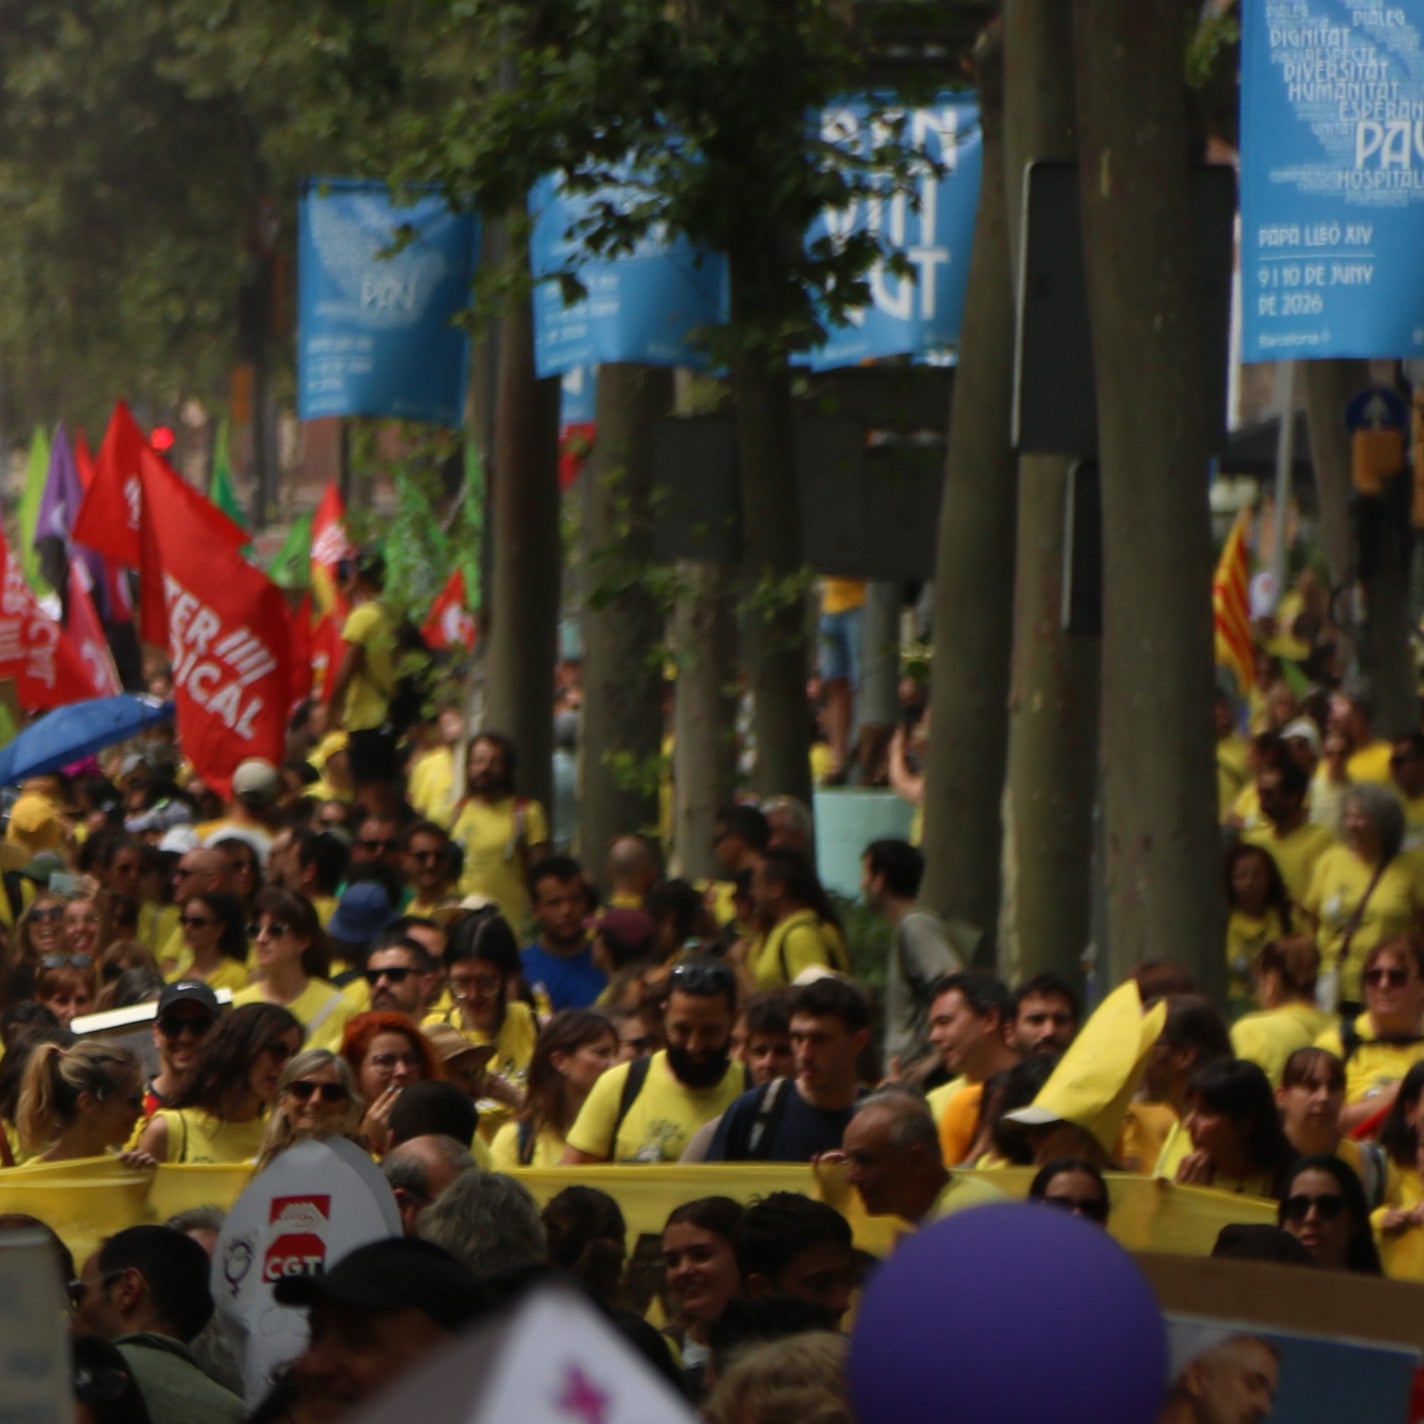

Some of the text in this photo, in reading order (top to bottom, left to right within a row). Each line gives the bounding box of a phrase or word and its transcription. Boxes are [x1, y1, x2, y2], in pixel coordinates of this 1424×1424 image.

[1269, 27, 1350, 49] DIGNITAT
[1283, 60, 1390, 83] DIVERSITAT
[1288, 81, 1400, 103] HUMANITAT
[1339, 101, 1424, 122] ESPERAN
[1338, 169, 1424, 191] HOSPITAL
[1345, 224, 1373, 245] XIV
[1283, 265, 1301, 286] 10
[1305, 265, 1326, 285] DE
[1330, 264, 1374, 285] JUNY
[1258, 294, 1324, 316] DE 2026
[265, 1254, 324, 1282] CGT
